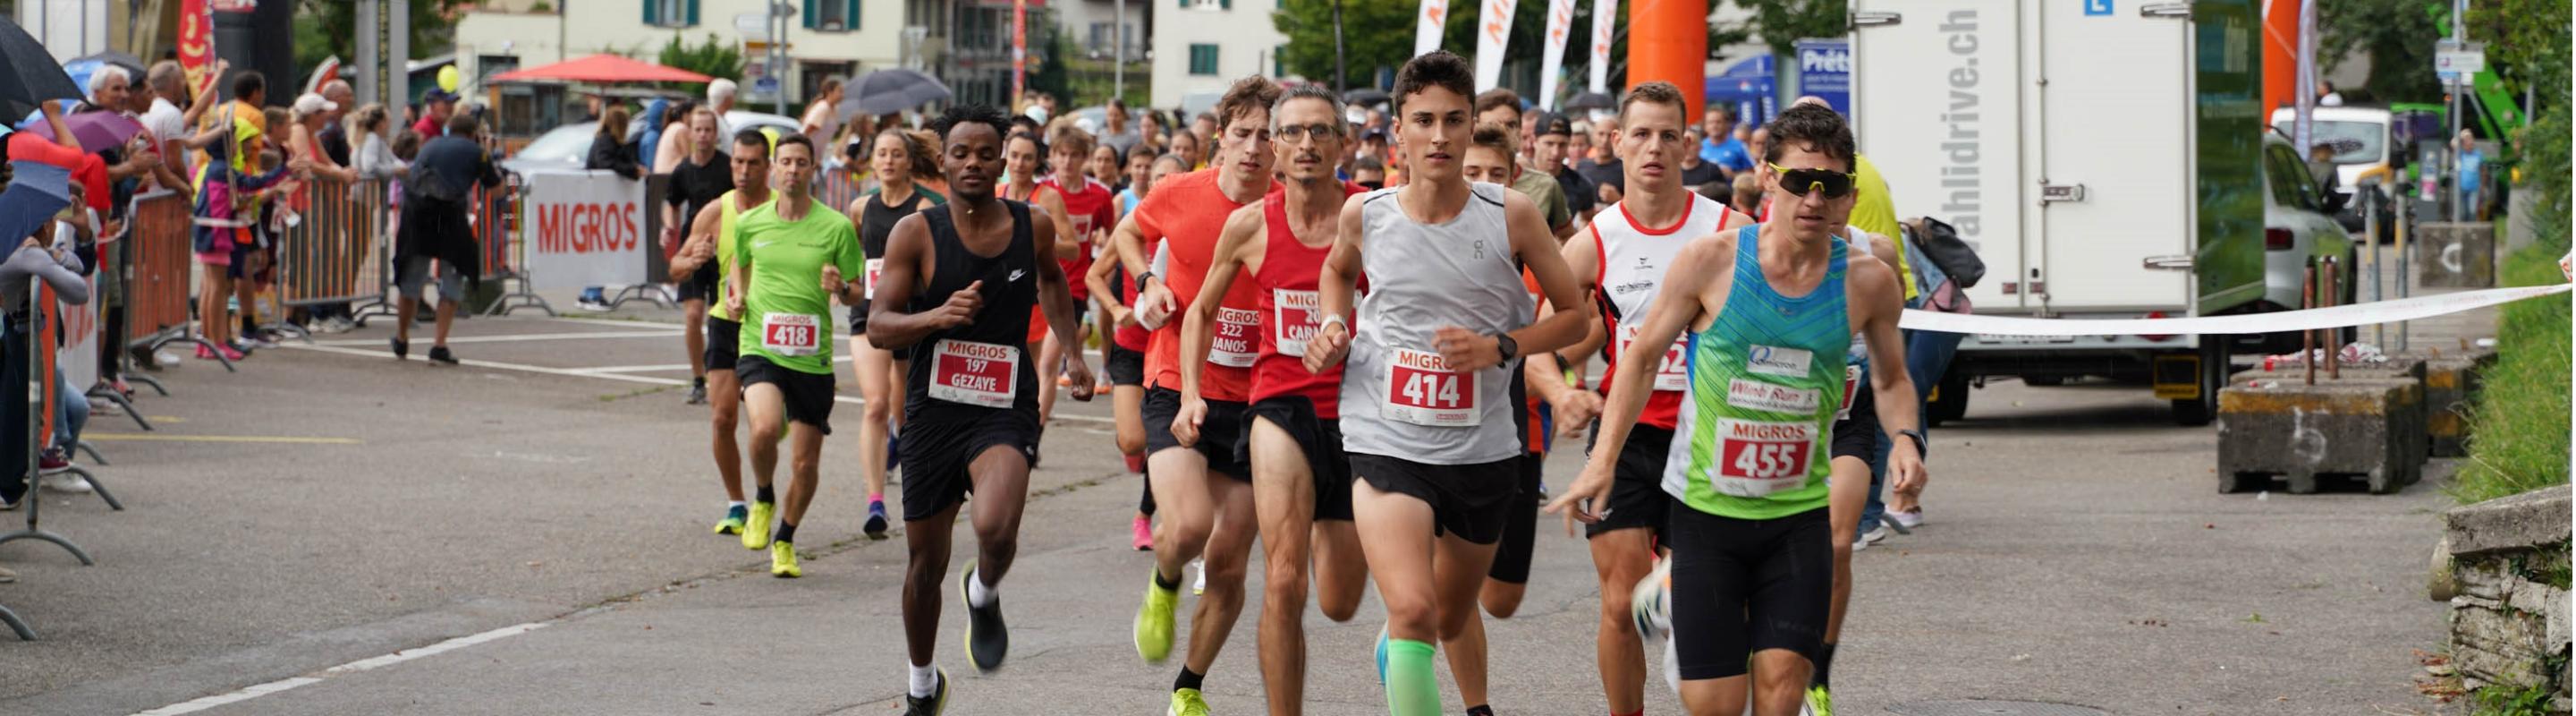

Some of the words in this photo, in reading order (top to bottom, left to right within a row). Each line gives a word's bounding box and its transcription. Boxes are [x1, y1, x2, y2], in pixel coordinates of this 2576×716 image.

[1938, 10, 1980, 251] ahlidrive.ch
[538, 200, 637, 253] MIGROS
[1286, 294, 1320, 306] MIG
[772, 314, 811, 324] MIGROS
[1218, 309, 1259, 323] IGROS
[774, 325, 808, 345] 418
[1220, 322, 1242, 337] 322
[947, 342, 1007, 359] MIGROS
[965, 358, 988, 373] 197
[951, 373, 996, 391] GEZAYE
[1402, 372, 1460, 407] 414
[1733, 422, 1805, 439] MIGROS
[1735, 443, 1796, 477] 455
